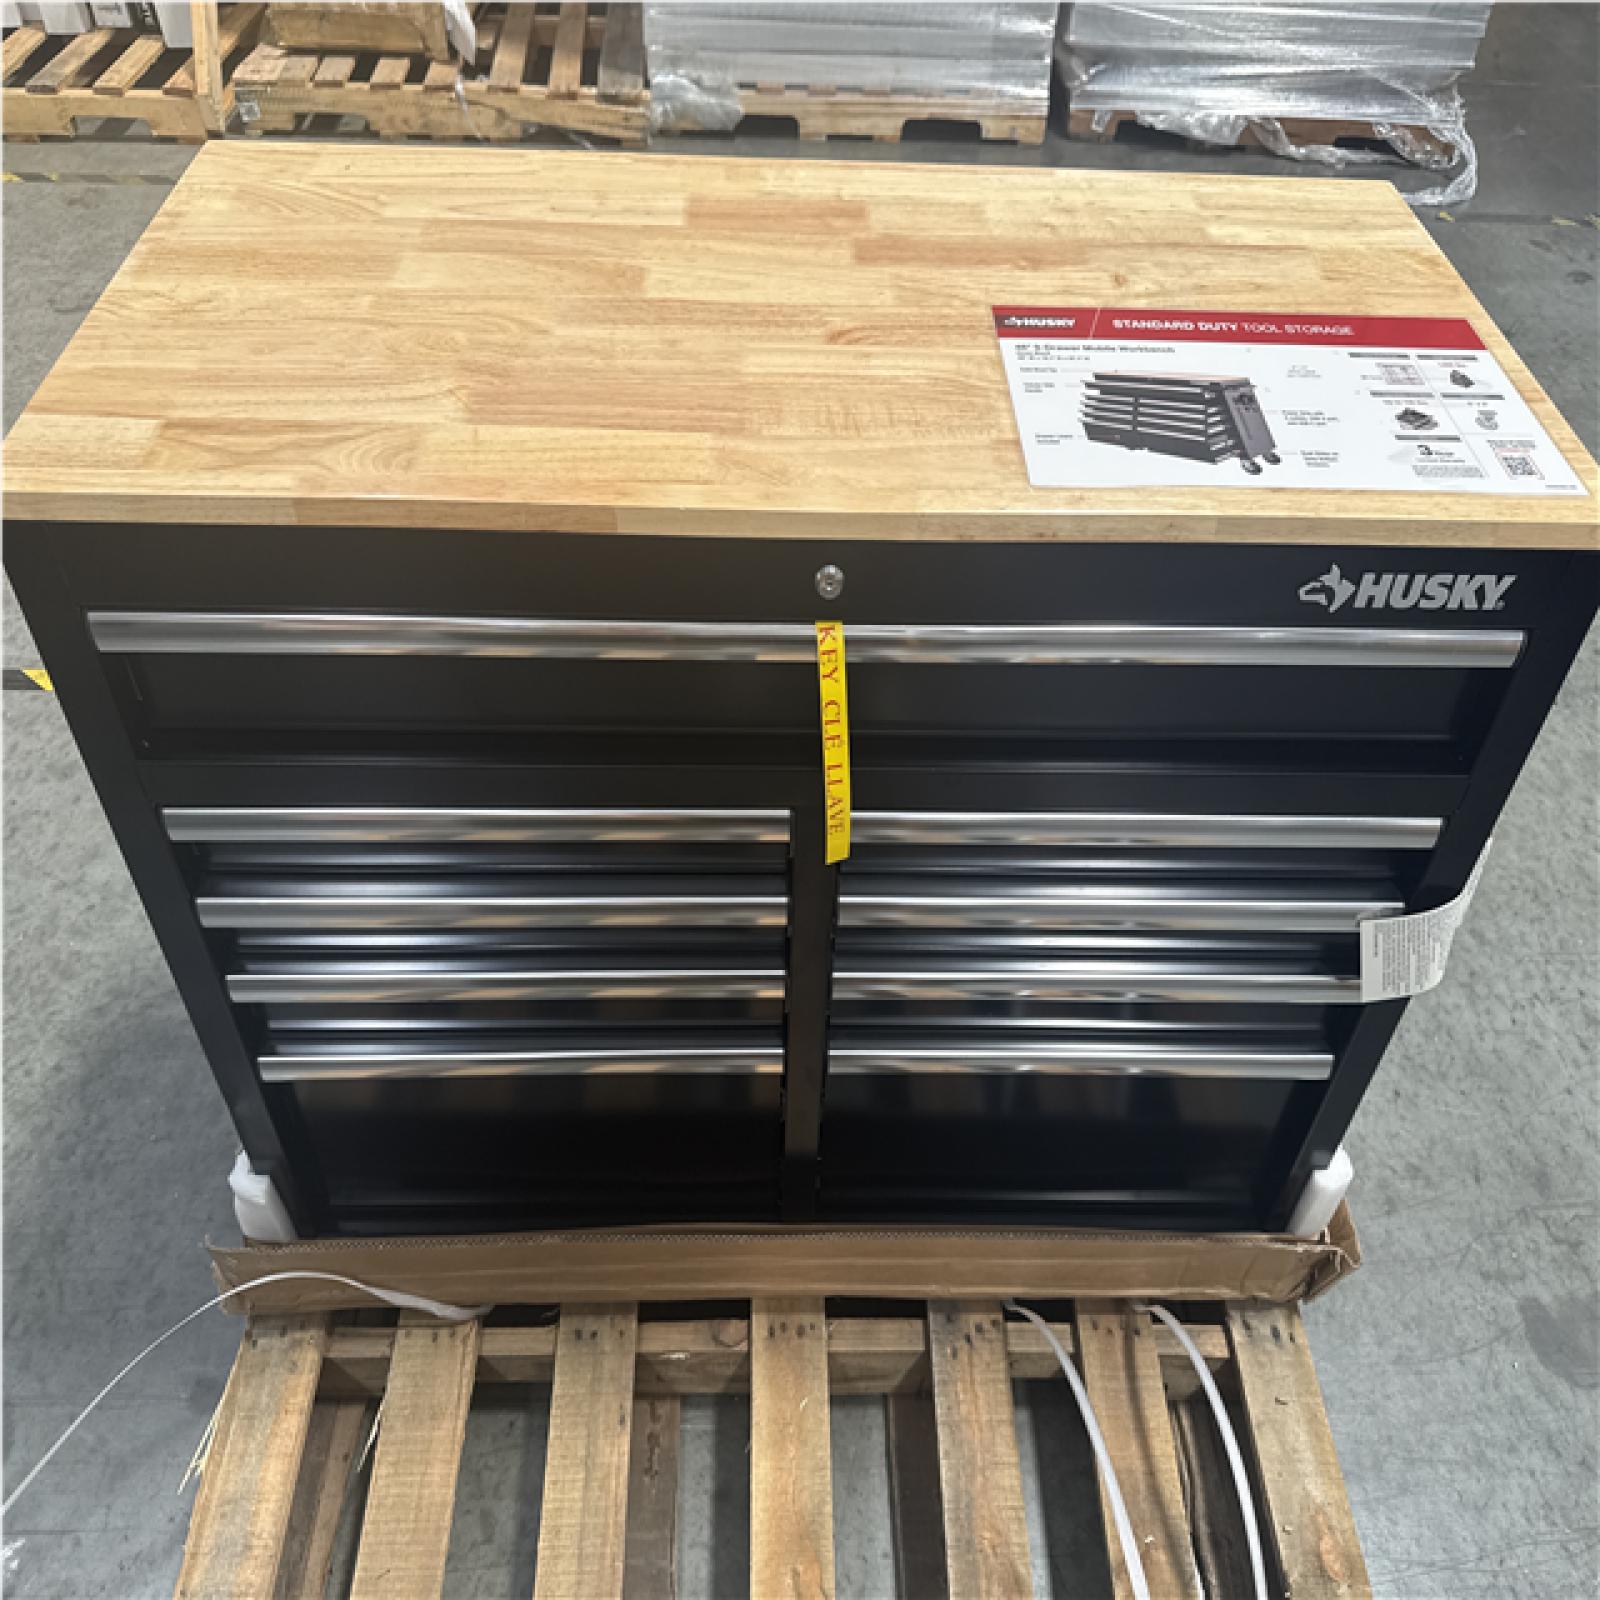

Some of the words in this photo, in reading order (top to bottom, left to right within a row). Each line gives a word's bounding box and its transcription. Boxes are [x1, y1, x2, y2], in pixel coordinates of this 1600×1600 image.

[1023, 317, 1076, 328] HUSKY
[1112, 319, 1195, 331] STANDARD
[1198, 322, 1238, 332] DUTY
[1244, 323, 1283, 334] TOOL
[1285, 324, 1355, 336] STORAGE
[1352, 571, 1518, 611] HUSKY
[819, 626, 839, 683] KEY
